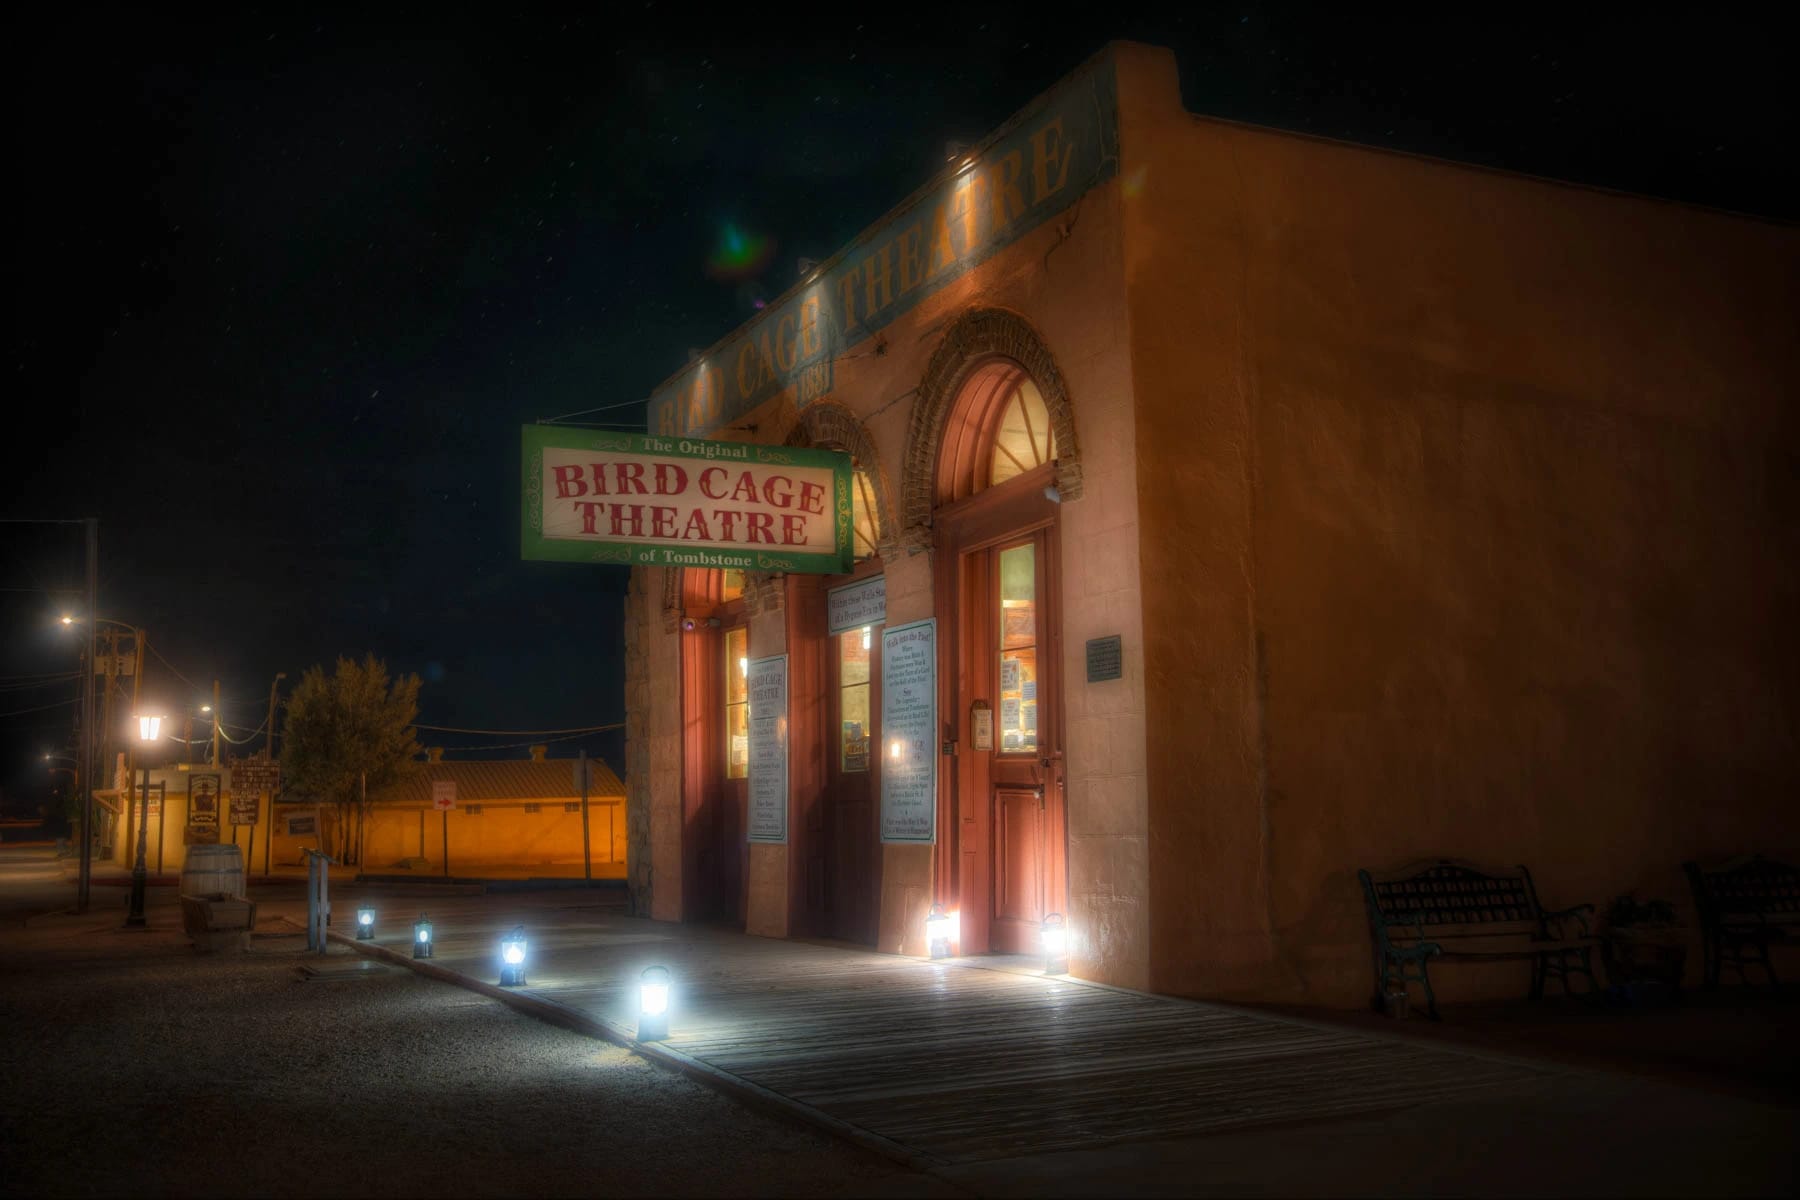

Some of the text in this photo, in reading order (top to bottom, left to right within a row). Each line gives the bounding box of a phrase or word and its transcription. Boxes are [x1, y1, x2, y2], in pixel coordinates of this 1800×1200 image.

[658, 115, 1074, 437] BIRD CAGE THEATRE
[642, 437, 747, 459] The Original
[552, 462, 826, 516] BIRD CAGE
[574, 501, 808, 546] THEATRE
[639, 549, 752, 567] of Tombstone
